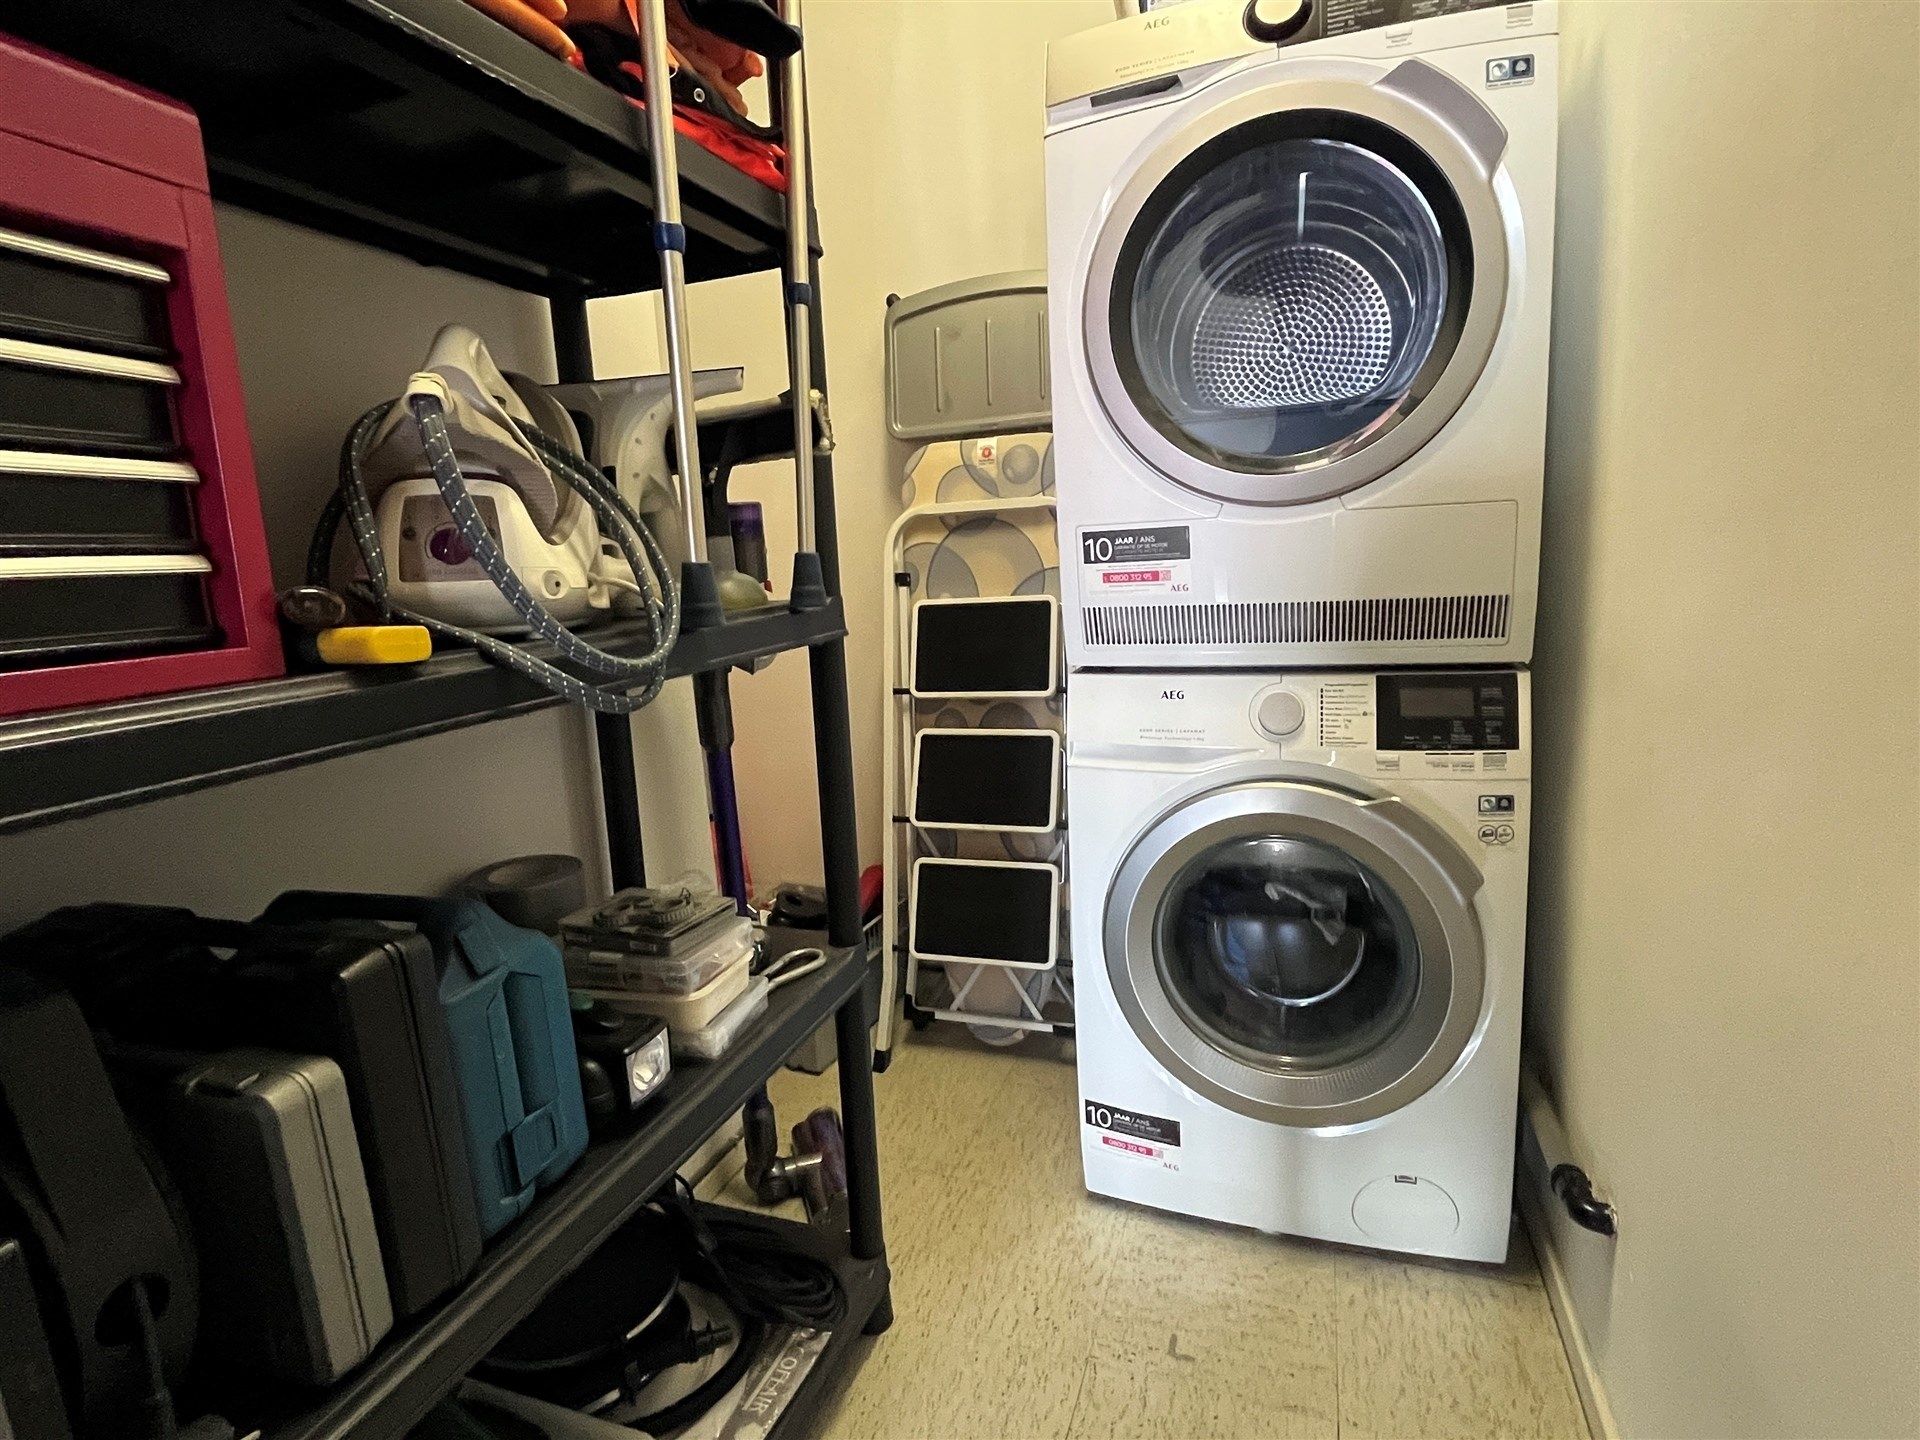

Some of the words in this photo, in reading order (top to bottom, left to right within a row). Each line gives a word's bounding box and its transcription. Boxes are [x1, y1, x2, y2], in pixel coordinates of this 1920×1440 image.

[1144, 16, 1170, 30] AEG
[1085, 538, 1112, 561] 10
[1114, 536, 1134, 545] JAAR
[1139, 535, 1156, 544] ANS
[1109, 574, 1129, 582] 0800
[1171, 584, 1189, 592] AEG
[1160, 690, 1185, 700] AEG
[1087, 1106, 1111, 1128] 10
[1163, 1162, 1179, 1171] AEG
